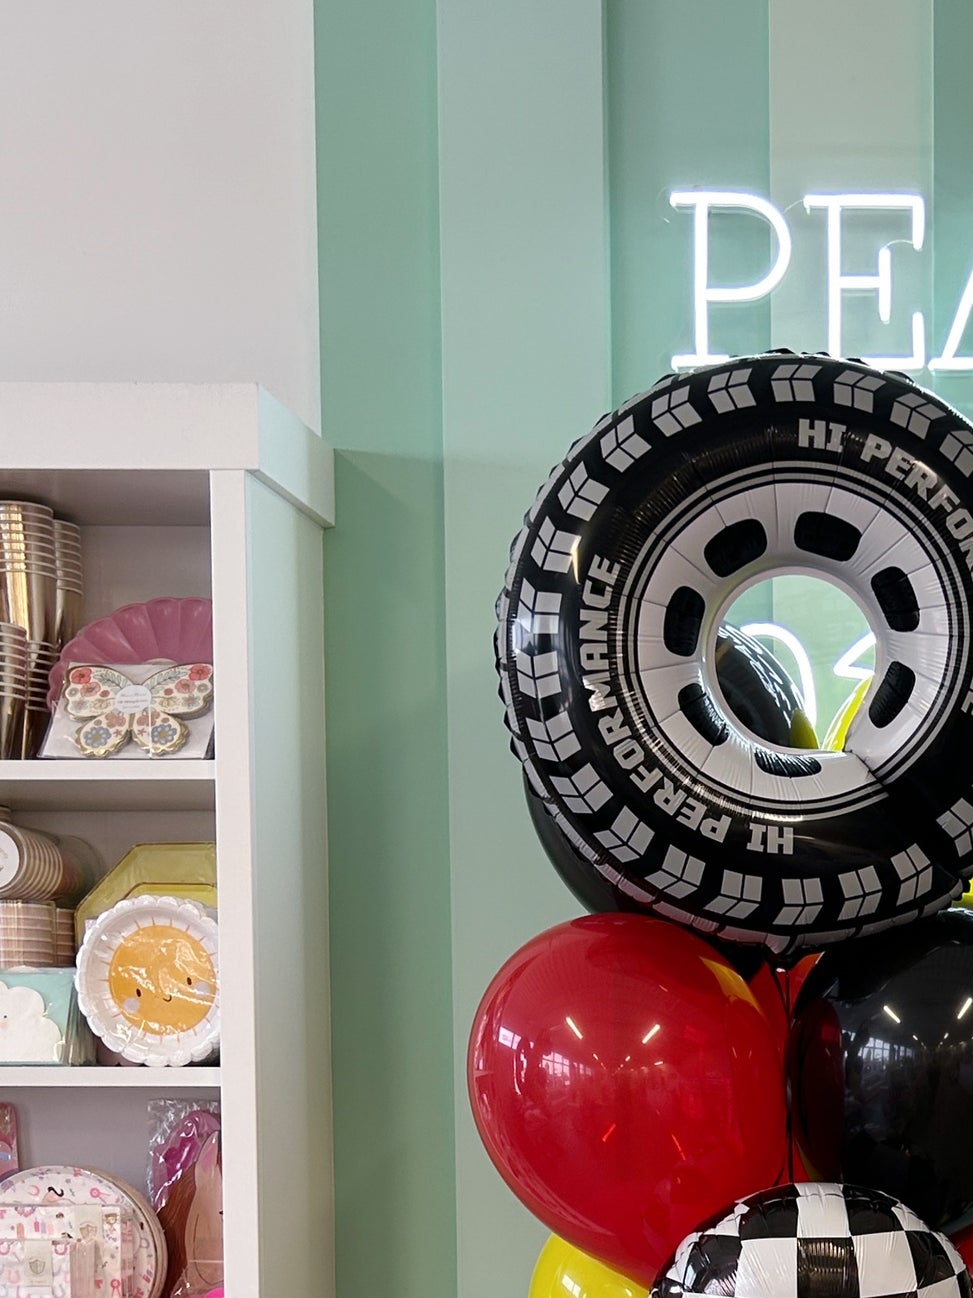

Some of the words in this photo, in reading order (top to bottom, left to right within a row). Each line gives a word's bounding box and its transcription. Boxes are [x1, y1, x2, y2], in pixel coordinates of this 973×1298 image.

[798, 418, 848, 454] HI
[578, 555, 729, 843] PERFORMANCE
[745, 825, 794, 856] HI
